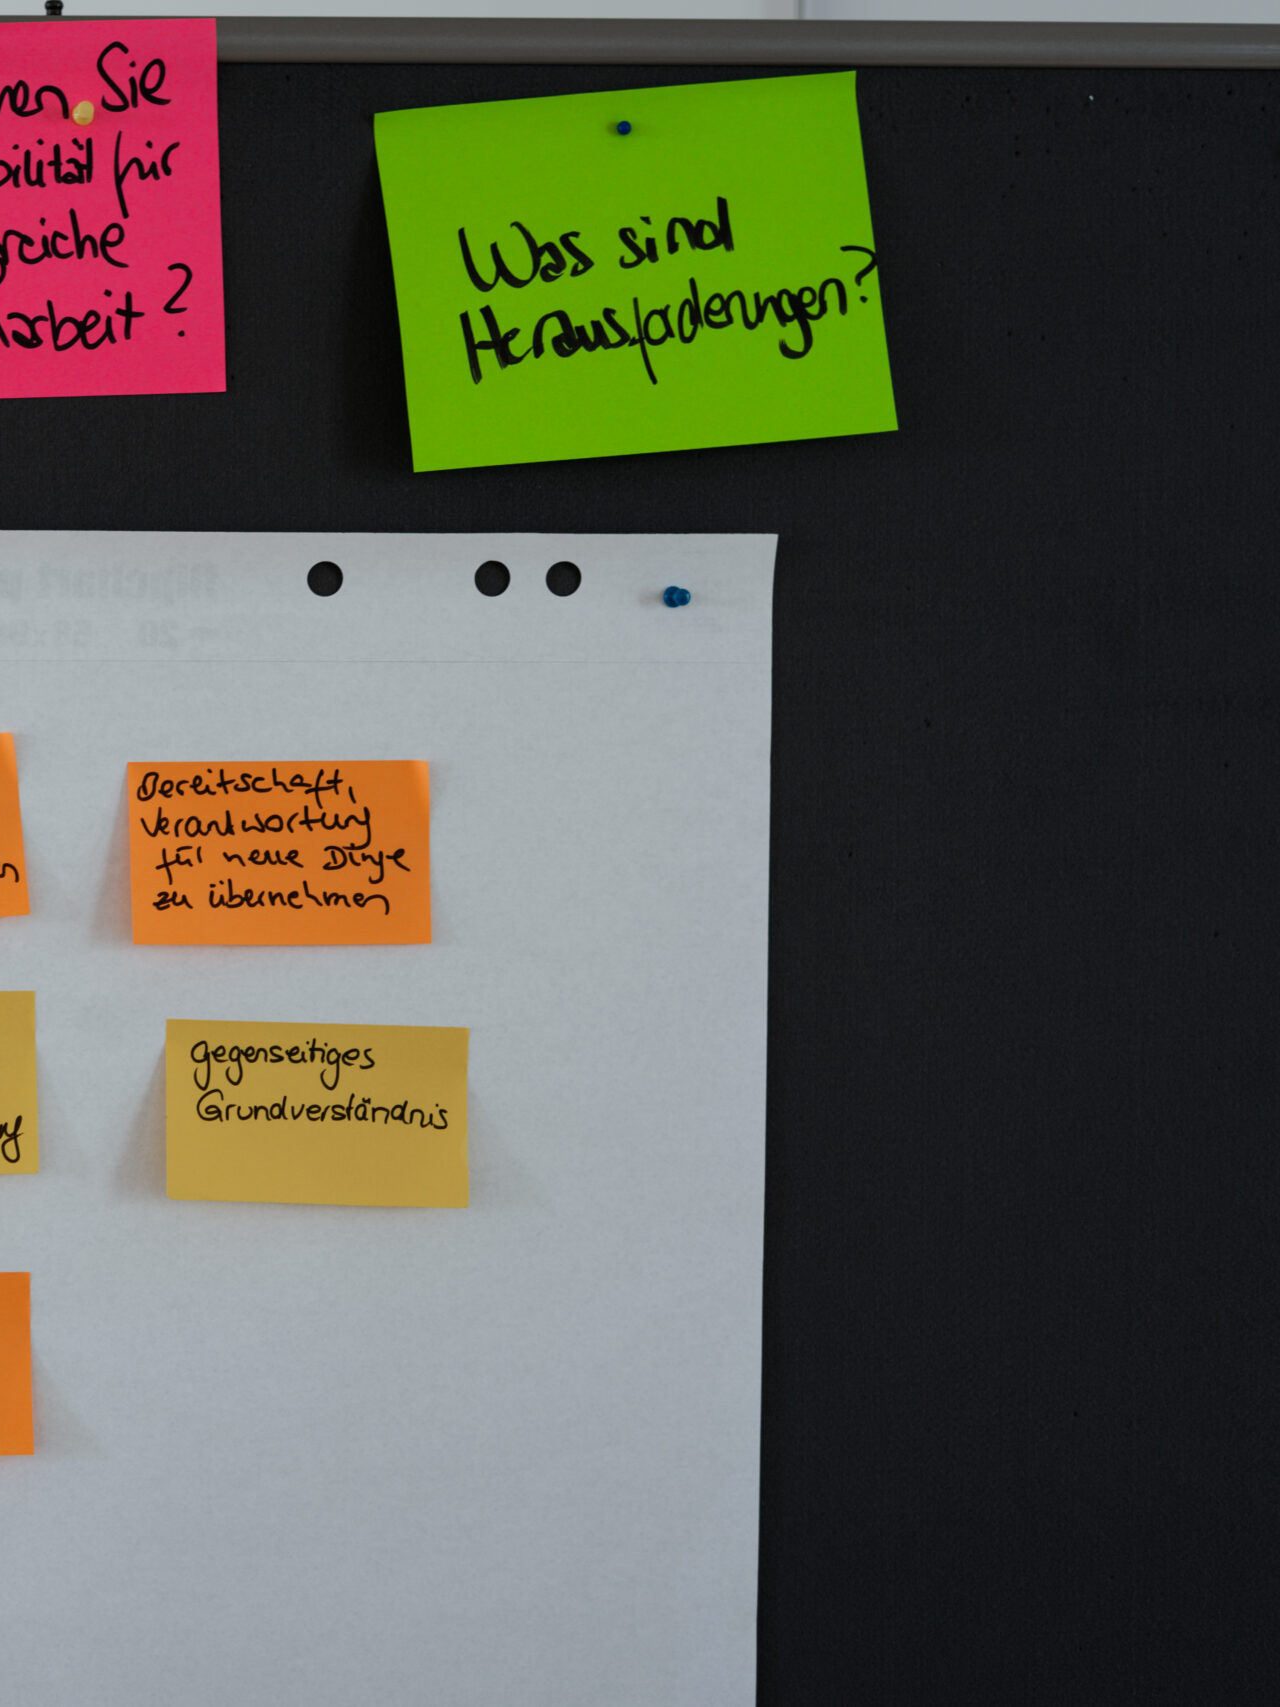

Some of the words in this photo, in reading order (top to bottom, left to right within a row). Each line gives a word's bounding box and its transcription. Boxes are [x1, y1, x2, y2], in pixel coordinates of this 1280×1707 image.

[95, 40, 173, 114] Sie
[116, 129, 181, 220] für
[457, 220, 595, 293] Was
[618, 195, 735, 270] sind
[155, 846, 203, 886] für
[222, 848, 304, 869] neue
[322, 842, 411, 885] Dinge
[153, 891, 194, 911] zu
[208, 878, 391, 916] übernehmen
[190, 1038, 376, 1091] gegenseitiges
[196, 1088, 449, 1130] Grundverständnis
